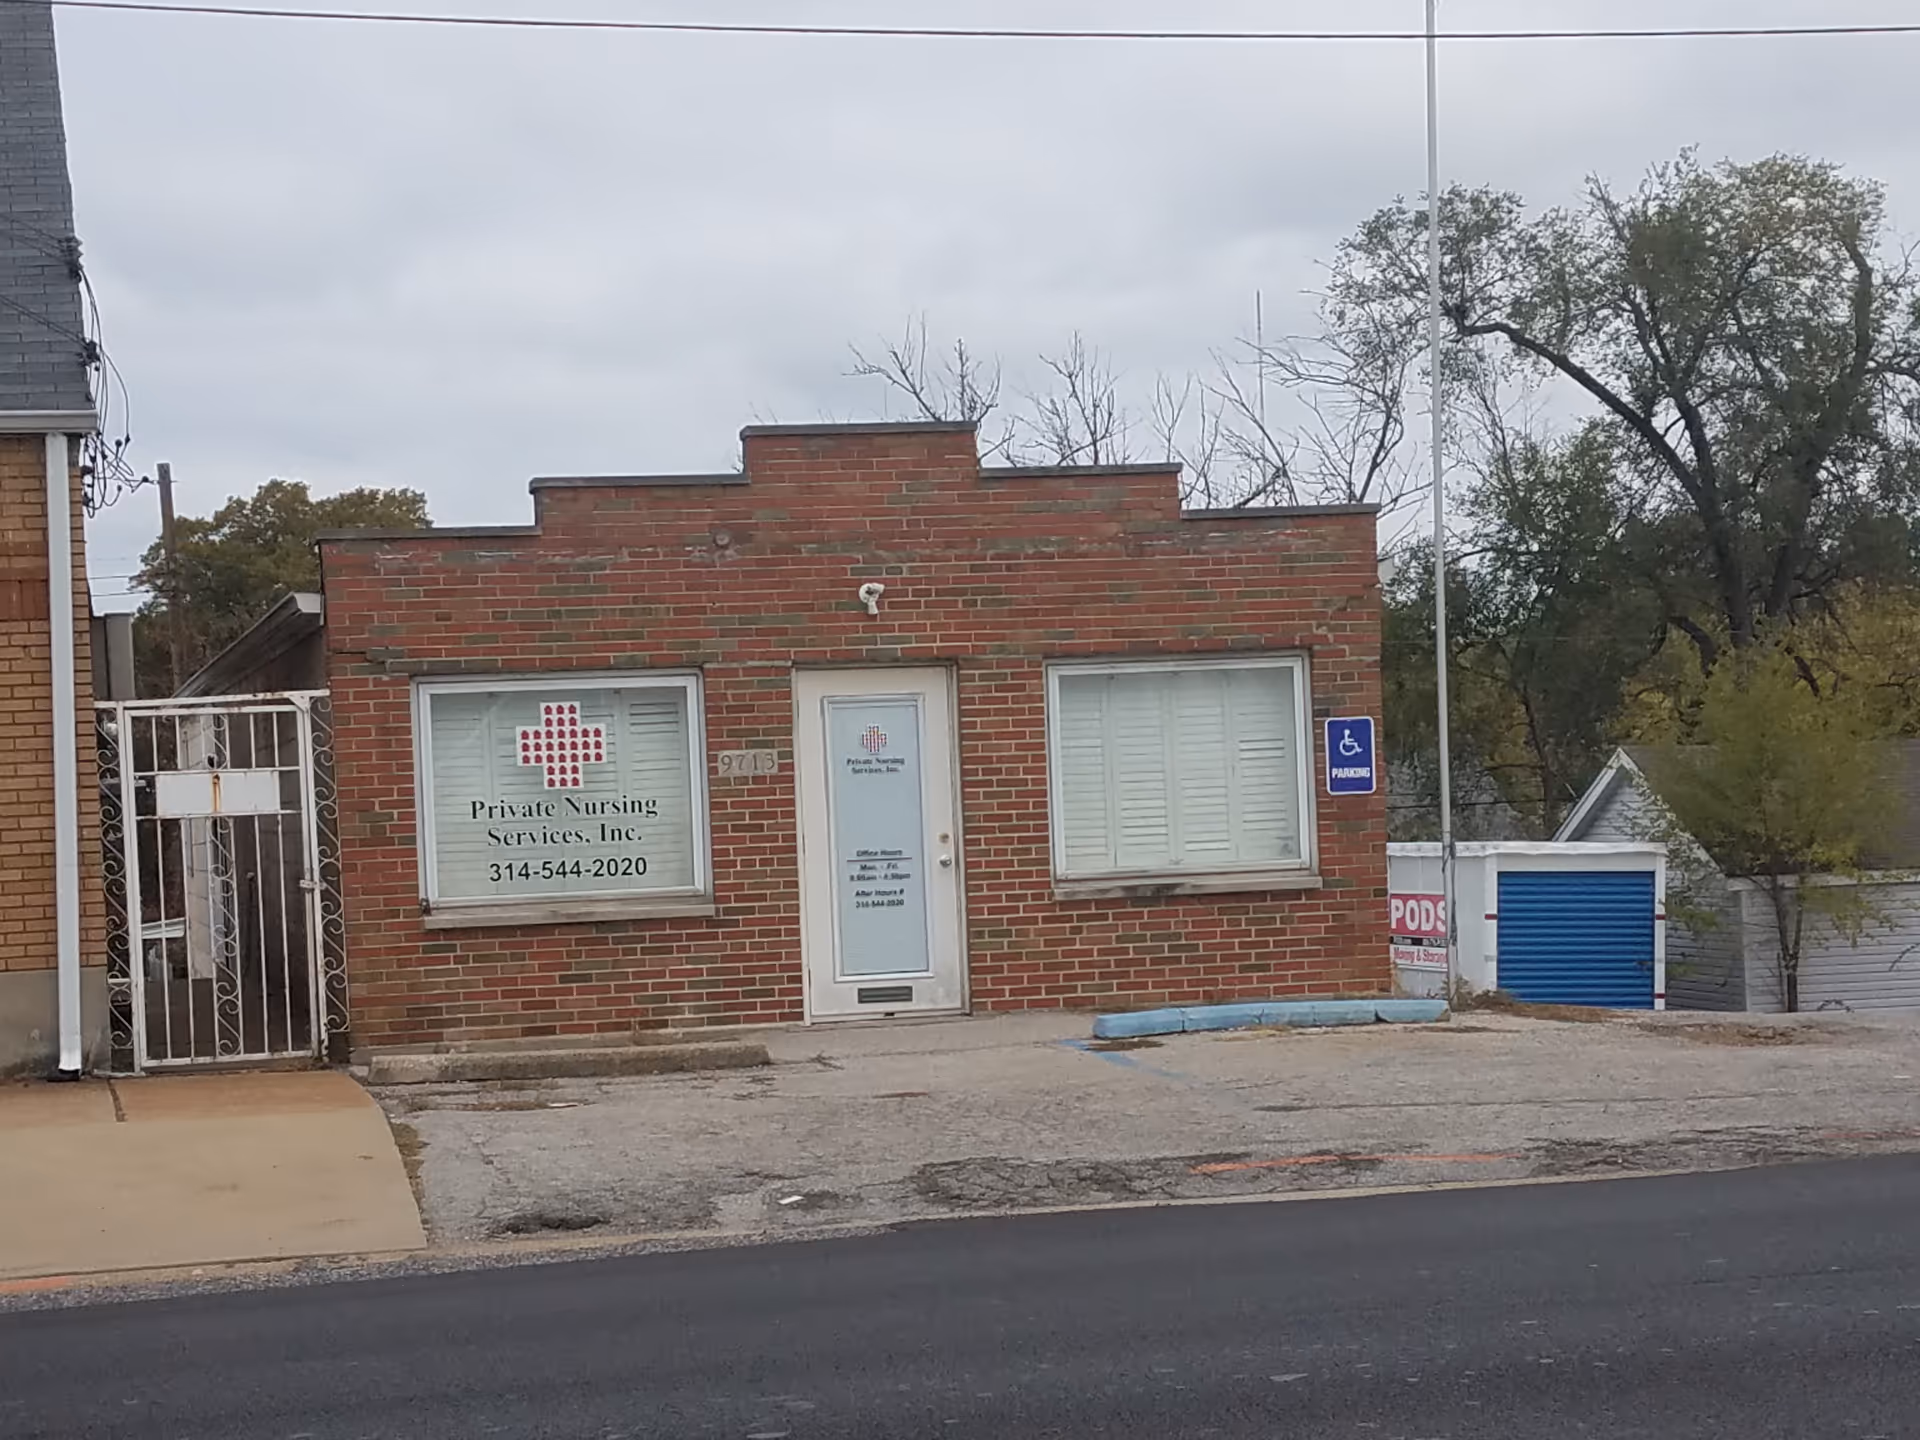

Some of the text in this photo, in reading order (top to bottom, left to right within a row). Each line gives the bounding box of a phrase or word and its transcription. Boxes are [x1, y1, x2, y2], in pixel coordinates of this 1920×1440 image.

[721, 753, 775, 773] 9713
[846, 757, 905, 765] Private Nursing
[1332, 767, 1371, 779] PARKING
[470, 795, 658, 820] Private Nursing
[488, 823, 642, 847] Services, Inc.
[489, 857, 648, 882] 314-544-2020
[1391, 898, 1446, 932] PODS
